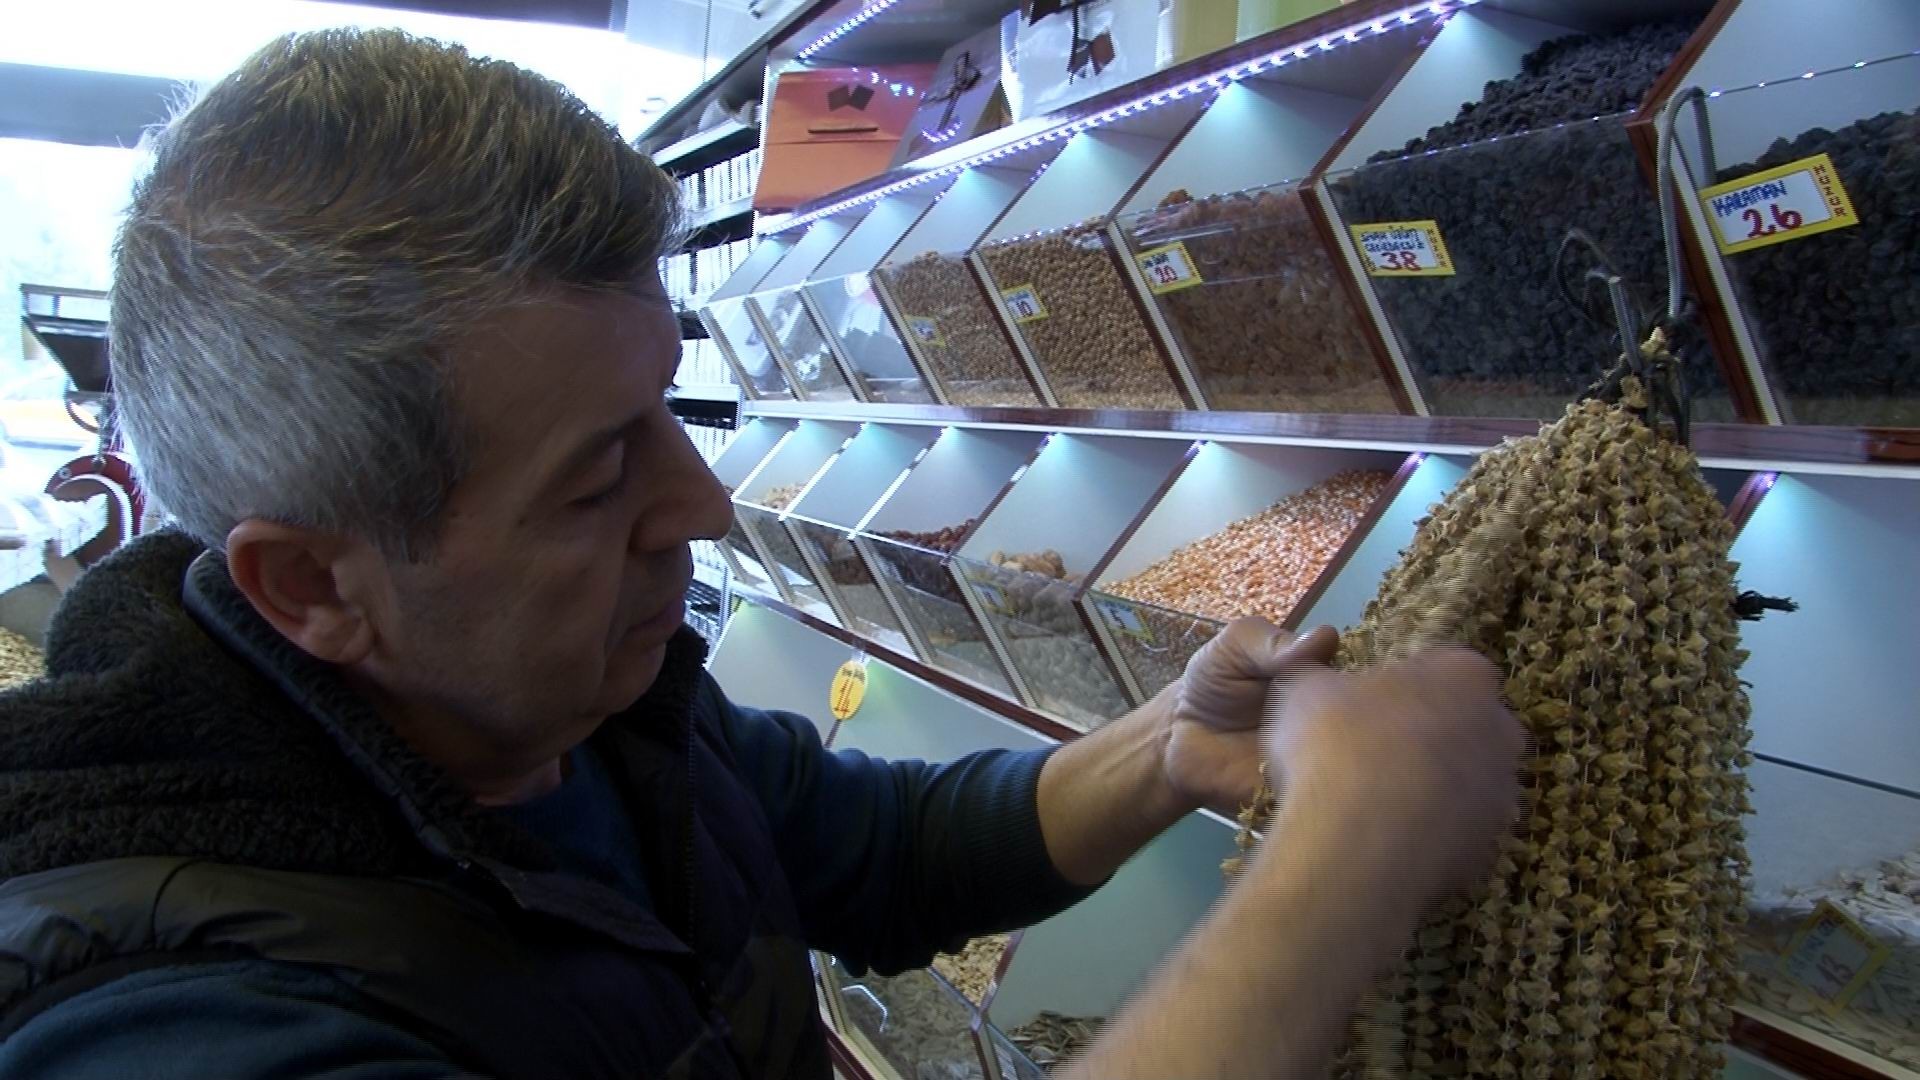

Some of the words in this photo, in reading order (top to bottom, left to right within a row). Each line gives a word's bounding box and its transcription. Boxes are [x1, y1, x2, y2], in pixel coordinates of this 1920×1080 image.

[1711, 179, 1788, 218] KARAMAN
[1812, 163, 1848, 218] HUZUR
[1742, 203, 1803, 239] 26
[1379, 250, 1423, 272] 38
